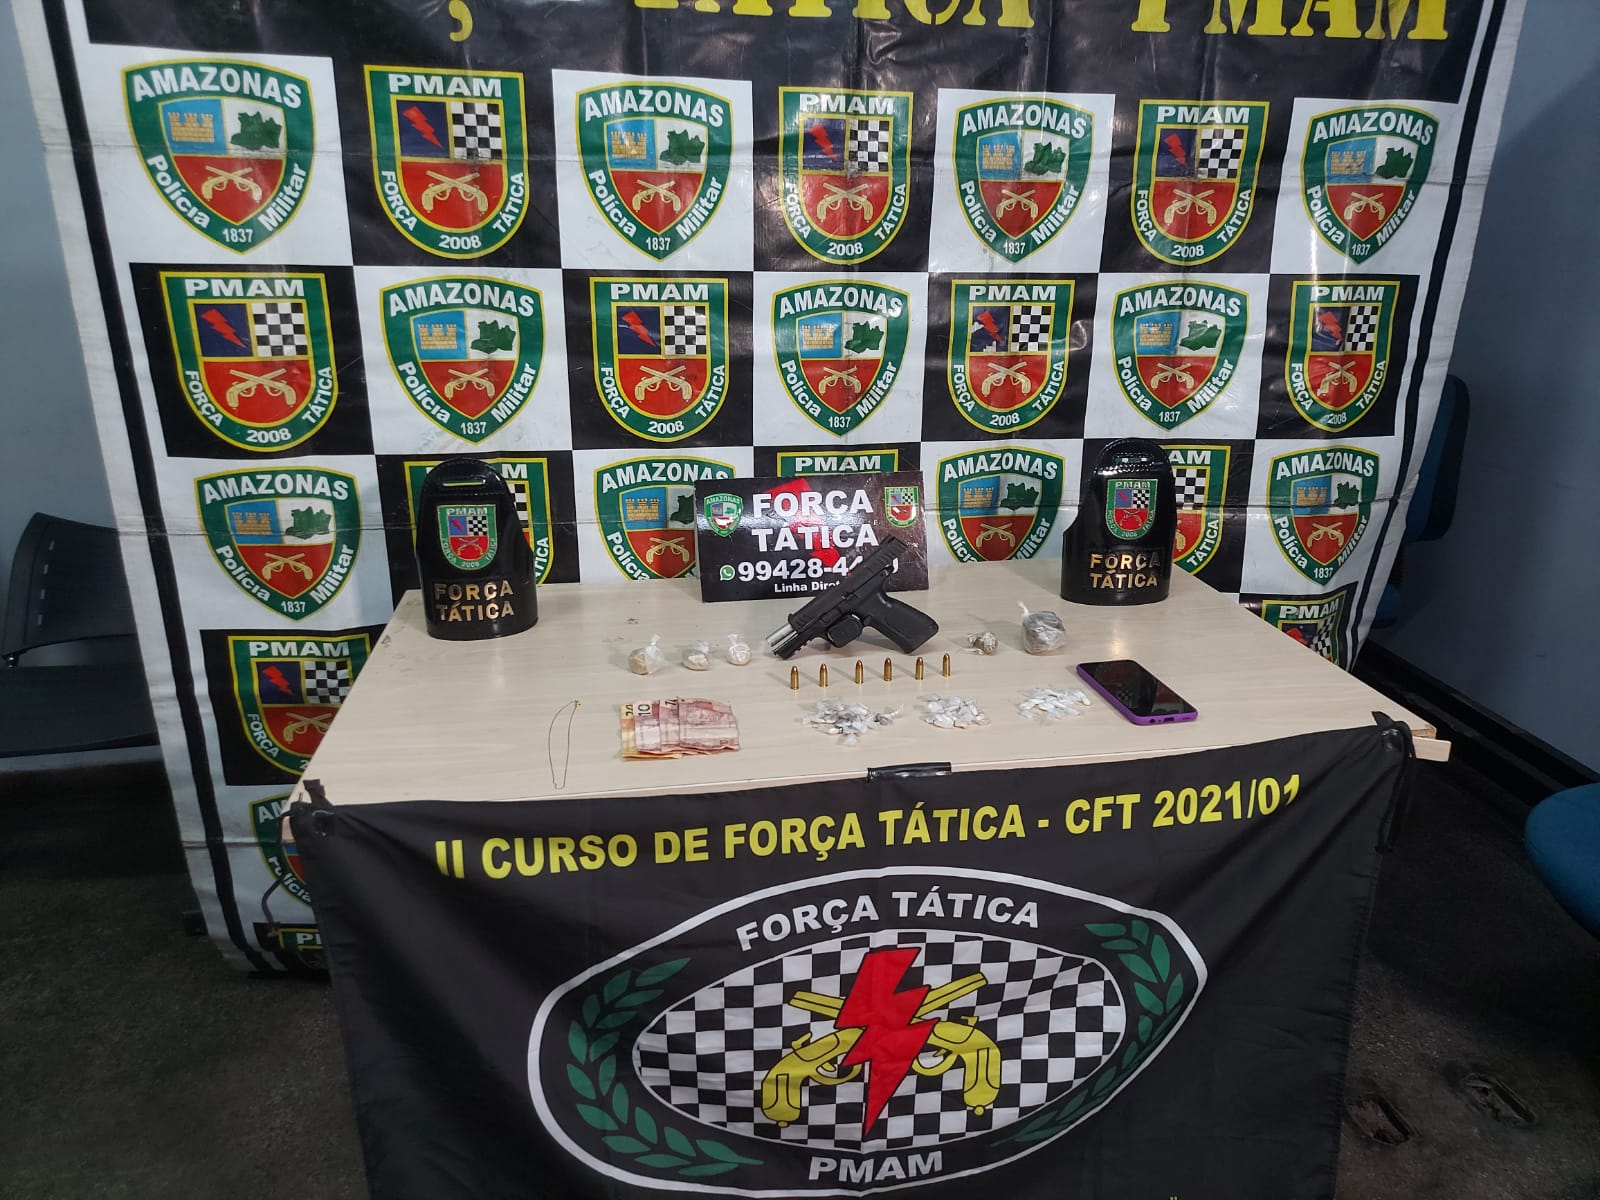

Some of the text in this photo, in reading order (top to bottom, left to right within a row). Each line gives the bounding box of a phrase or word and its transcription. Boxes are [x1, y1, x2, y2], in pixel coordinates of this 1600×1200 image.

[133, 66, 301, 109] AMAZONAS
[388, 73, 502, 97] PMAM
[585, 89, 724, 128] AMAZONAS
[800, 93, 894, 115] PMAM
[1157, 106, 1250, 124] PMAM
[962, 104, 1087, 140] AMAZONAS
[1313, 111, 1433, 146] AMAZONAS
[258, 163, 306, 232] Militar
[381, 170, 417, 231] FORÇA
[492, 172, 524, 233] TÁTICA
[675, 176, 722, 241] Militar
[785, 183, 812, 239] FORÇA
[874, 183, 906, 241] TÁTICA
[1031, 184, 1079, 245] Militar
[1136, 189, 1157, 242] FORÇA
[1216, 189, 1251, 243] TÁTICA
[1375, 189, 1416, 247] Militar
[222, 228, 253, 243] 1837
[438, 234, 482, 250] 2008
[646, 237, 671, 251] 1837
[826, 242, 864, 256] 2008
[1003, 242, 1026, 255] 1837
[1351, 243, 1371, 256] 1837
[1171, 245, 1205, 258] 2008
[184, 279, 304, 297] PMAM
[389, 283, 534, 318] AMAZONAS
[610, 283, 709, 300] PMAM
[779, 286, 904, 319] AMAZONAS
[969, 285, 1057, 301] PMAM
[1119, 286, 1241, 317] AMAZONAS
[1310, 286, 1385, 302] PMAM
[185, 370, 223, 426] FORÇA
[301, 366, 333, 424] TÁTICA
[490, 363, 536, 423] Militar
[600, 367, 631, 419] FORÇA
[694, 364, 725, 418] TÁTICA
[855, 361, 897, 419] Militar
[953, 364, 976, 412] FORÇA
[1031, 360, 1065, 412] TÁTICA
[1186, 359, 1234, 414] Militar
[1291, 362, 1315, 410] FORÇA
[1355, 360, 1386, 409] TÁTICA
[460, 422, 487, 434] 1837
[647, 420, 685, 434] 2008
[828, 416, 851, 428] 1837
[989, 412, 1020, 426] 2008
[1158, 411, 1181, 422] 1837
[246, 428, 291, 444] 2008
[795, 455, 881, 472] PMAM
[943, 452, 1058, 483] AMAZONAS
[1168, 450, 1211, 465] AM
[1276, 452, 1375, 481] AMAZONAS
[203, 473, 349, 505] AMAZONAS
[1115, 481, 1151, 489] PMAM
[446, 507, 488, 516] PMAM
[752, 489, 874, 520] FORÇA
[535, 537, 549, 577] TICA
[1186, 519, 1219, 567] TÁTICA
[309, 543, 354, 604] Militar
[1090, 553, 1160, 571] FORÇA
[1313, 567, 1333, 579] 1837
[434, 579, 514, 601] FORÇA
[774, 582, 808, 593] Linha
[1090, 569, 1158, 589] TÁTICA
[280, 600, 306, 613] 1837
[436, 601, 515, 622] TÁTICA
[1279, 598, 1340, 619] PMAM
[248, 641, 350, 657] PMAM
[637, 704, 651, 716] 10
[434, 839, 465, 879] II
[481, 833, 639, 879] CURSO
[654, 827, 710, 865] DE
[724, 812, 866, 861] FORÇA
[879, 801, 1026, 846] TÁTICA
[1037, 817, 1050, 828] -
[1064, 793, 1141, 835] CFT
[736, 886, 1039, 951] FORÇA TÁTICA
[807, 1150, 944, 1184] PMAM
